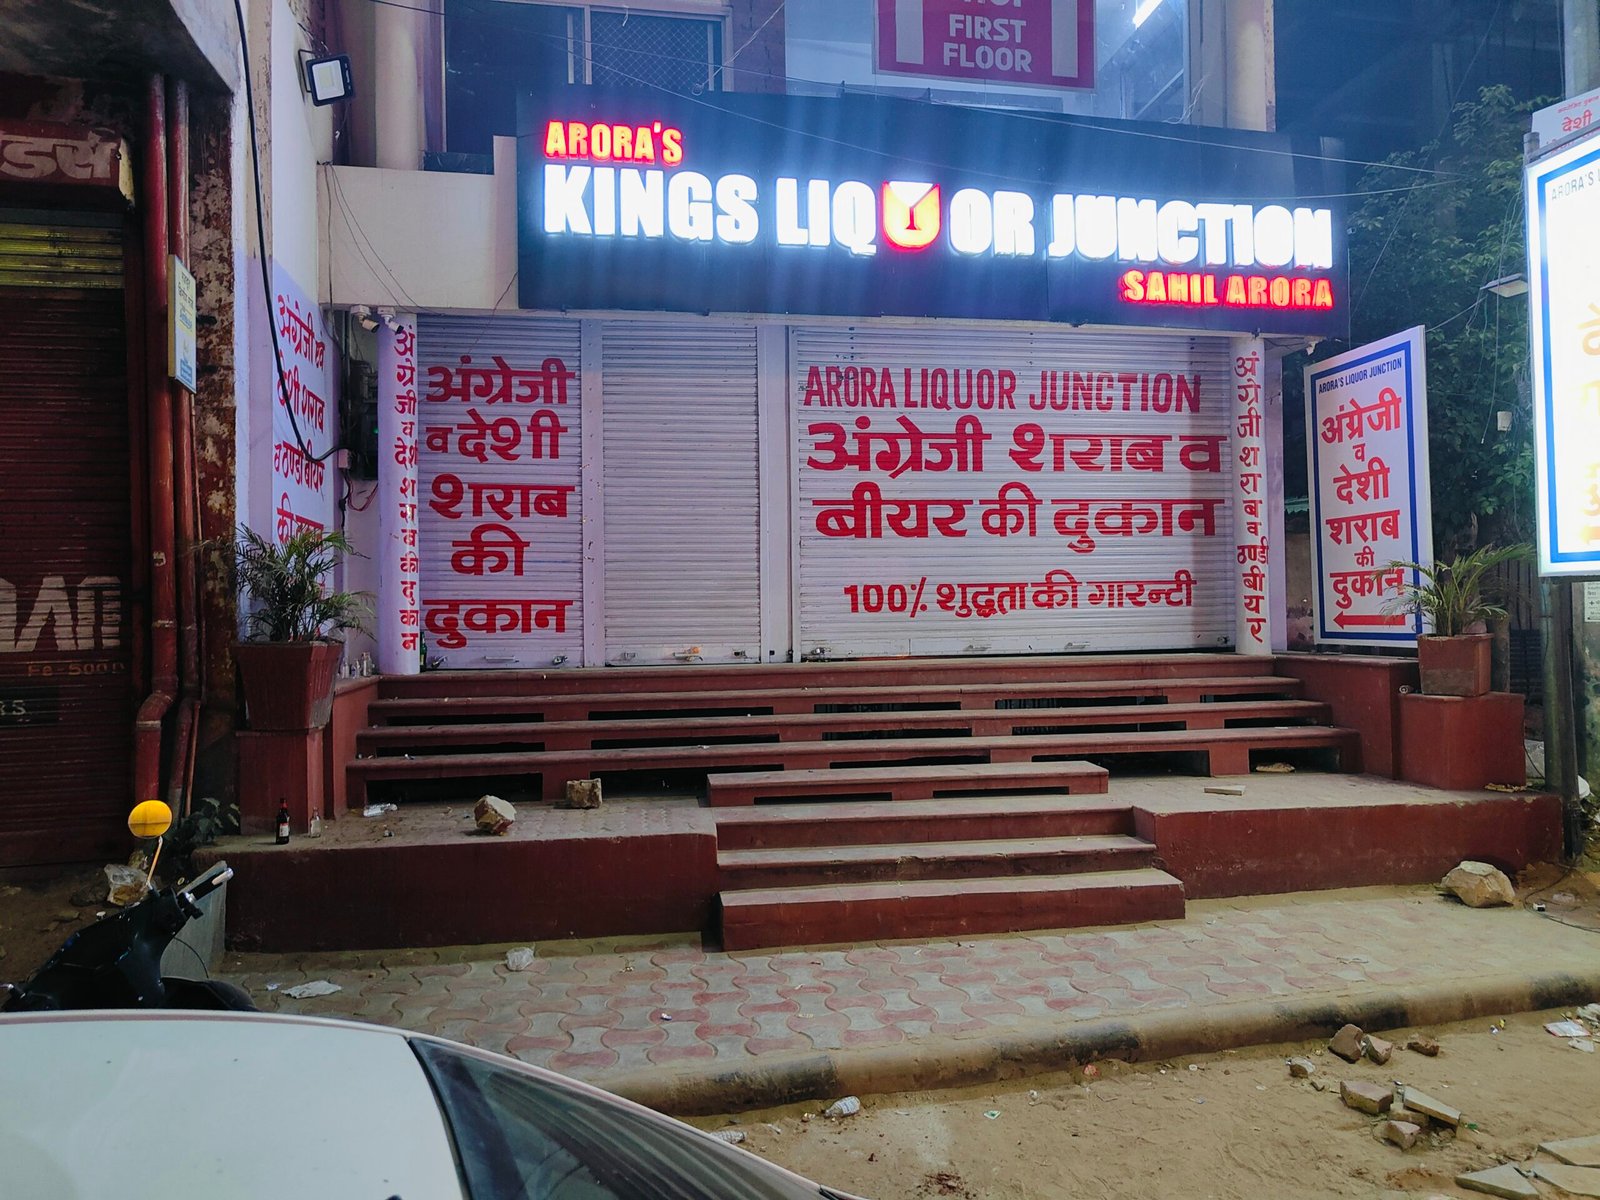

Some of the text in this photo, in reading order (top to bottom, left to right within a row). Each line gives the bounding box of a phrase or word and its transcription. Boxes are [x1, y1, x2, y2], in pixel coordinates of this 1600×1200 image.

[950, 14, 1027, 43] FIRST
[943, 42, 1032, 73] FLOOR
[544, 120, 683, 166] ARORA'S
[1561, 109, 1593, 132] देशी
[543, 163, 1333, 269] KINGS LIQUOR JUNCTION
[1121, 268, 1334, 311] SAHIL ARORA
[426, 355, 576, 405] अंग्रेजी
[803, 365, 1202, 414] ARORA LIQUOR JUNCTION
[1318, 357, 1402, 394] ARORA'S LIQUOR JUNCTION
[425, 408, 569, 463] व देशी
[1320, 387, 1402, 444] अंग्रेजी
[806, 414, 1228, 479] अंग्रेजी शराब व
[1352, 442, 1366, 462] व
[428, 473, 576, 521] शराब
[1333, 456, 1391, 504] देशी
[812, 481, 1225, 554] बीयर की दुकान
[1246, 521, 1262, 536] व
[1325, 509, 1400, 545] शराब
[451, 523, 530, 577] की
[1354, 545, 1375, 567] की
[843, 576, 928, 618] 100%
[1030, 569, 1083, 610] की
[1086, 569, 1198, 608] गारन्टी
[1329, 568, 1405, 610] दुकान
[422, 599, 574, 649] दुकान
